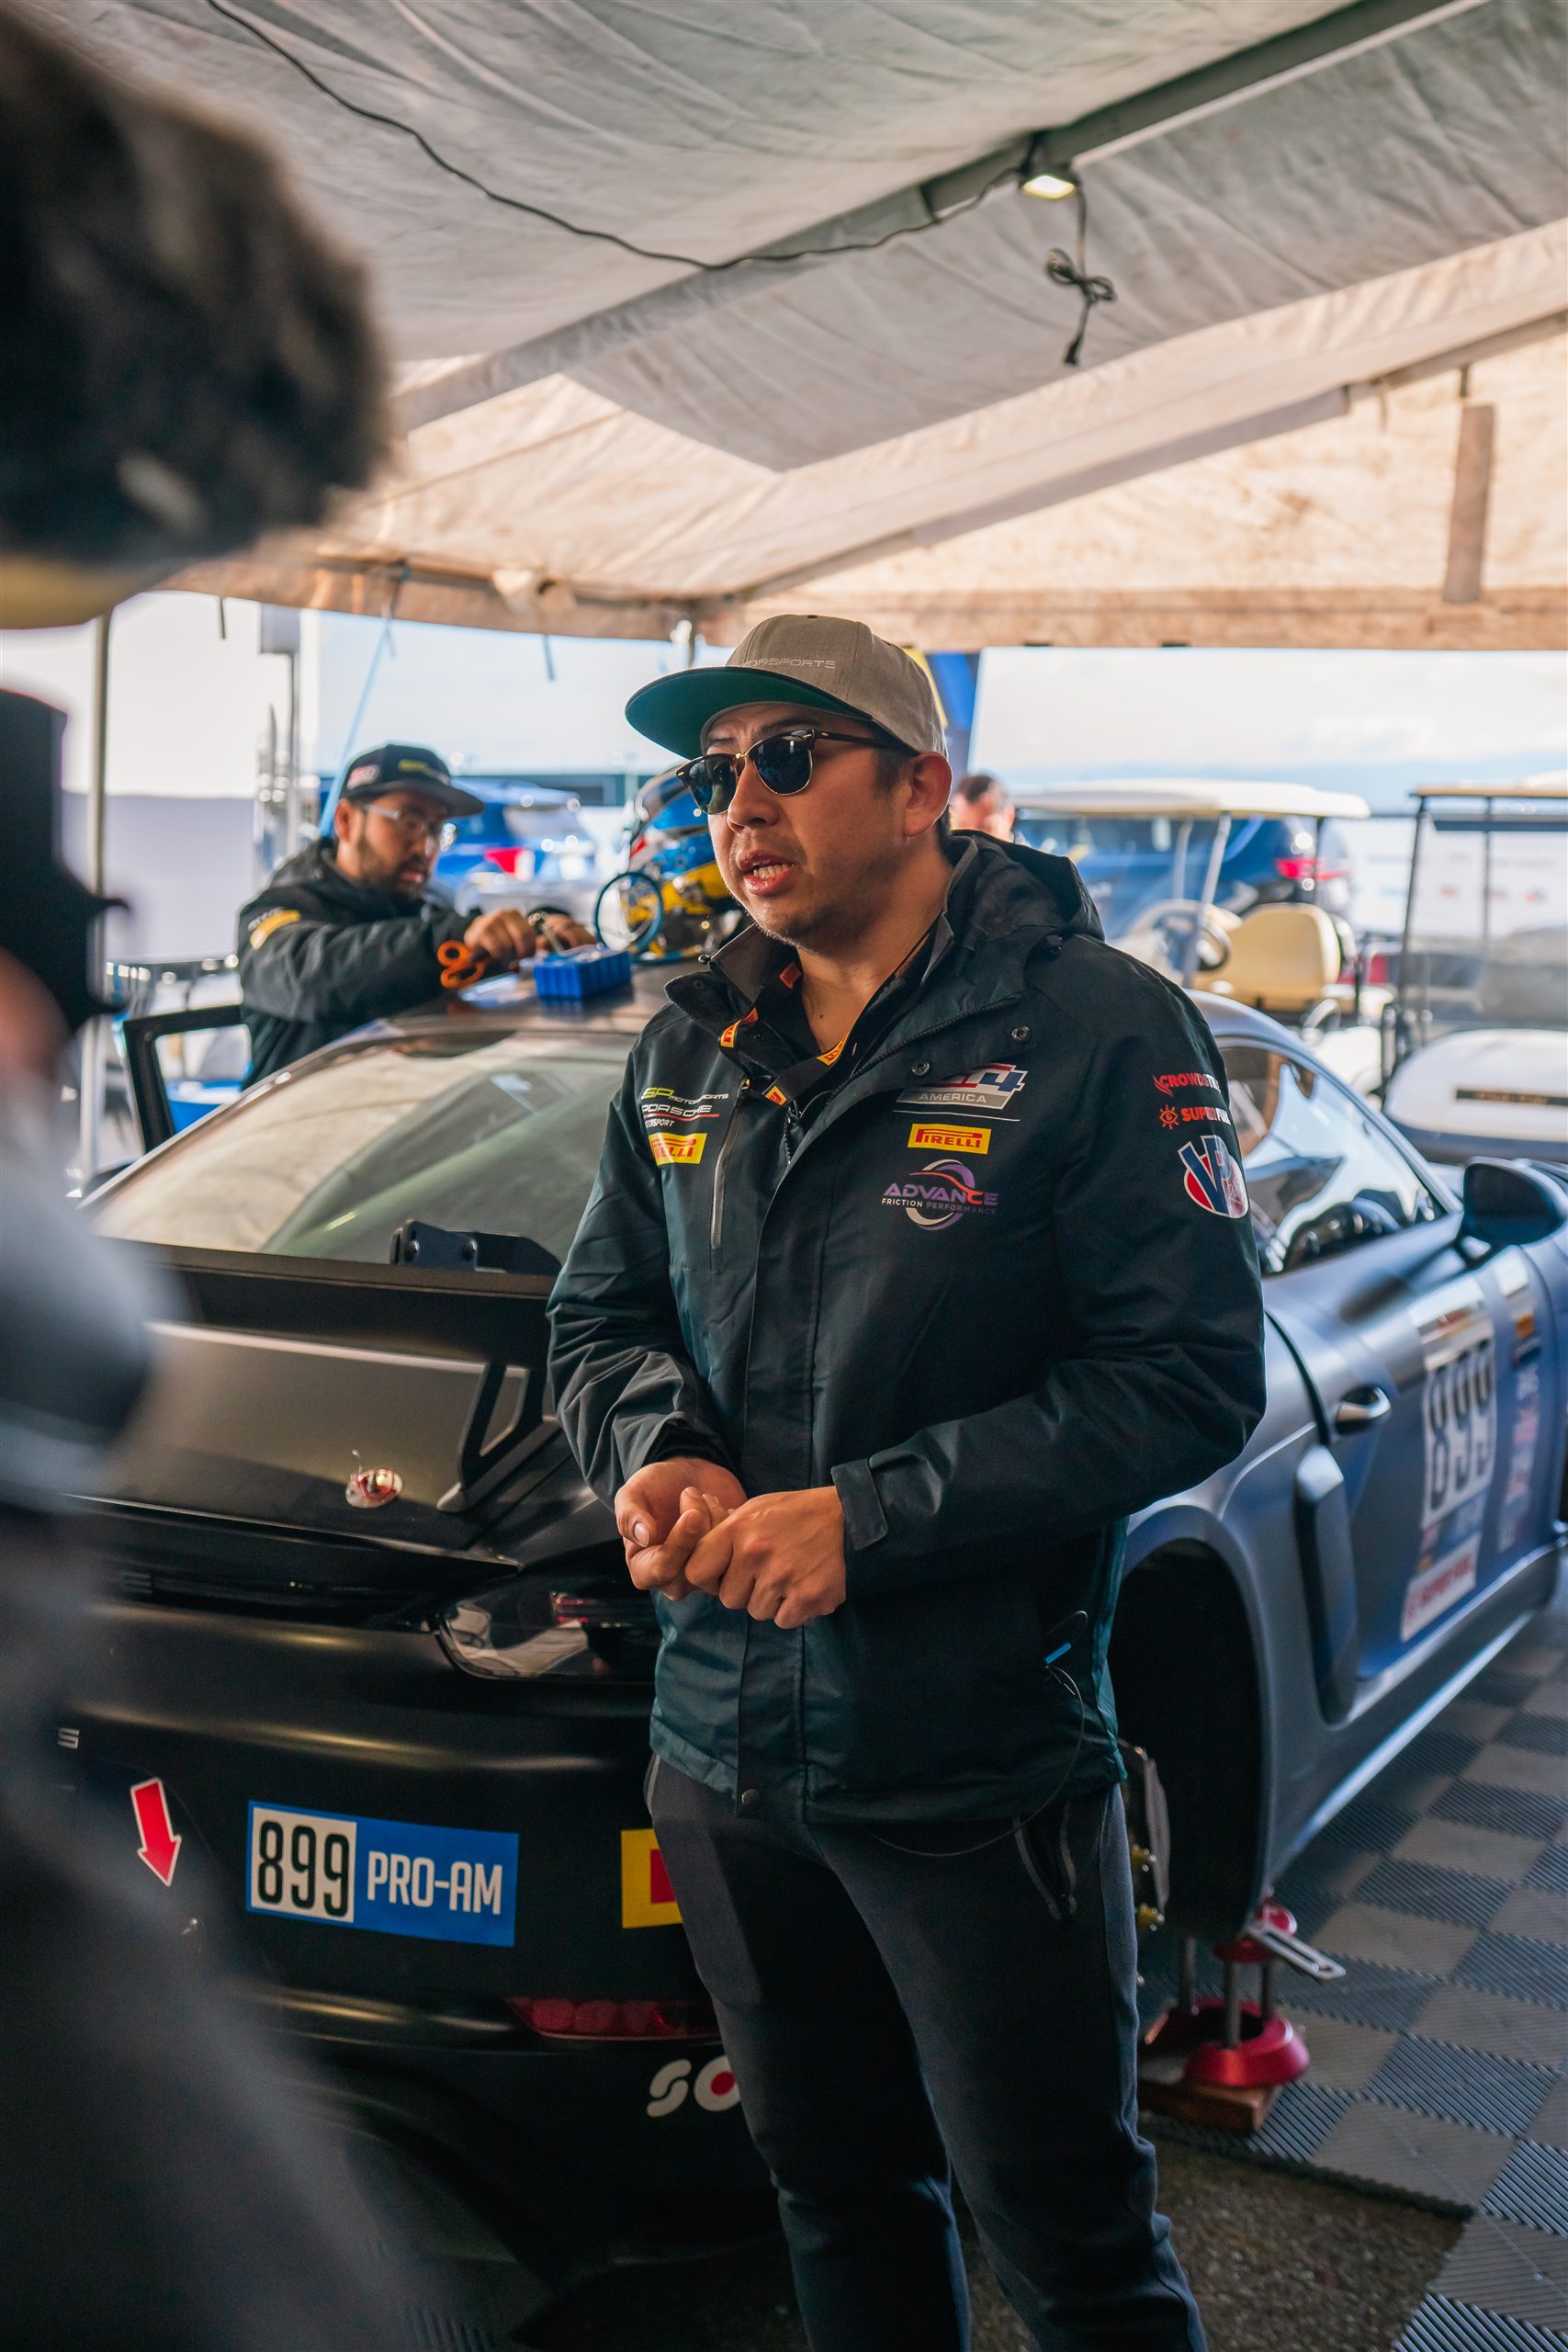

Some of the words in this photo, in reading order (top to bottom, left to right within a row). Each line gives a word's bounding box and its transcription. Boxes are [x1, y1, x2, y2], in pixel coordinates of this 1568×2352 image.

[743, 658, 836, 669] ORSPORTS
[641, 1087, 675, 1100] SP
[919, 1092, 987, 1103] AMERICA
[915, 1128, 983, 1148] PIRELLI
[883, 1182, 999, 1205] ADVANCE
[881, 1197, 923, 1208] FRICTION
[925, 1201, 998, 1216] PERFORMANCE
[257, 1820, 349, 1918] 899
[367, 1850, 502, 1916] PRO-AM
